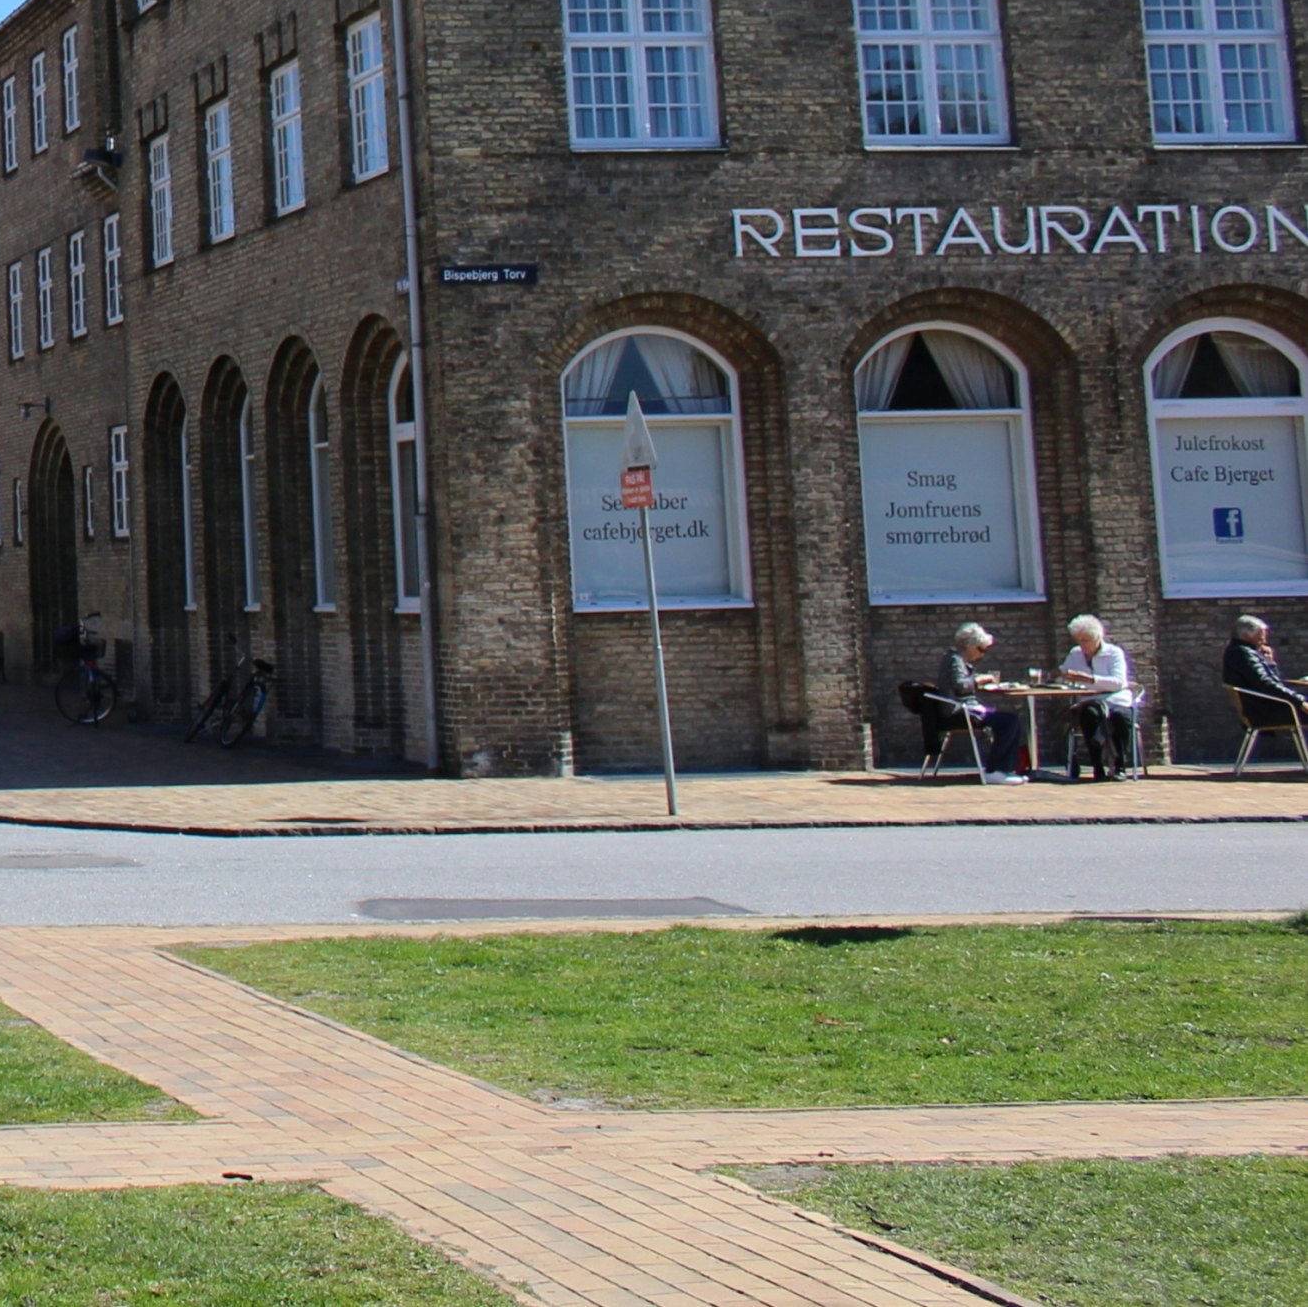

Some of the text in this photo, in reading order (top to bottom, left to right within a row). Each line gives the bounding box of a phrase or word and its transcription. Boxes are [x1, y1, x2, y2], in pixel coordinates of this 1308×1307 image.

[731, 204, 1308, 257] RESTAURATION
[443, 268, 526, 281] Bispebjerg Torv
[1175, 435, 1265, 451] Julefrokost
[907, 471, 957, 491] Smag
[1170, 465, 1275, 486] Cafe Bjerget
[602, 493, 688, 511] Seaber
[885, 500, 982, 518] Jomfruens
[886, 525, 991, 545] smørrebrød
